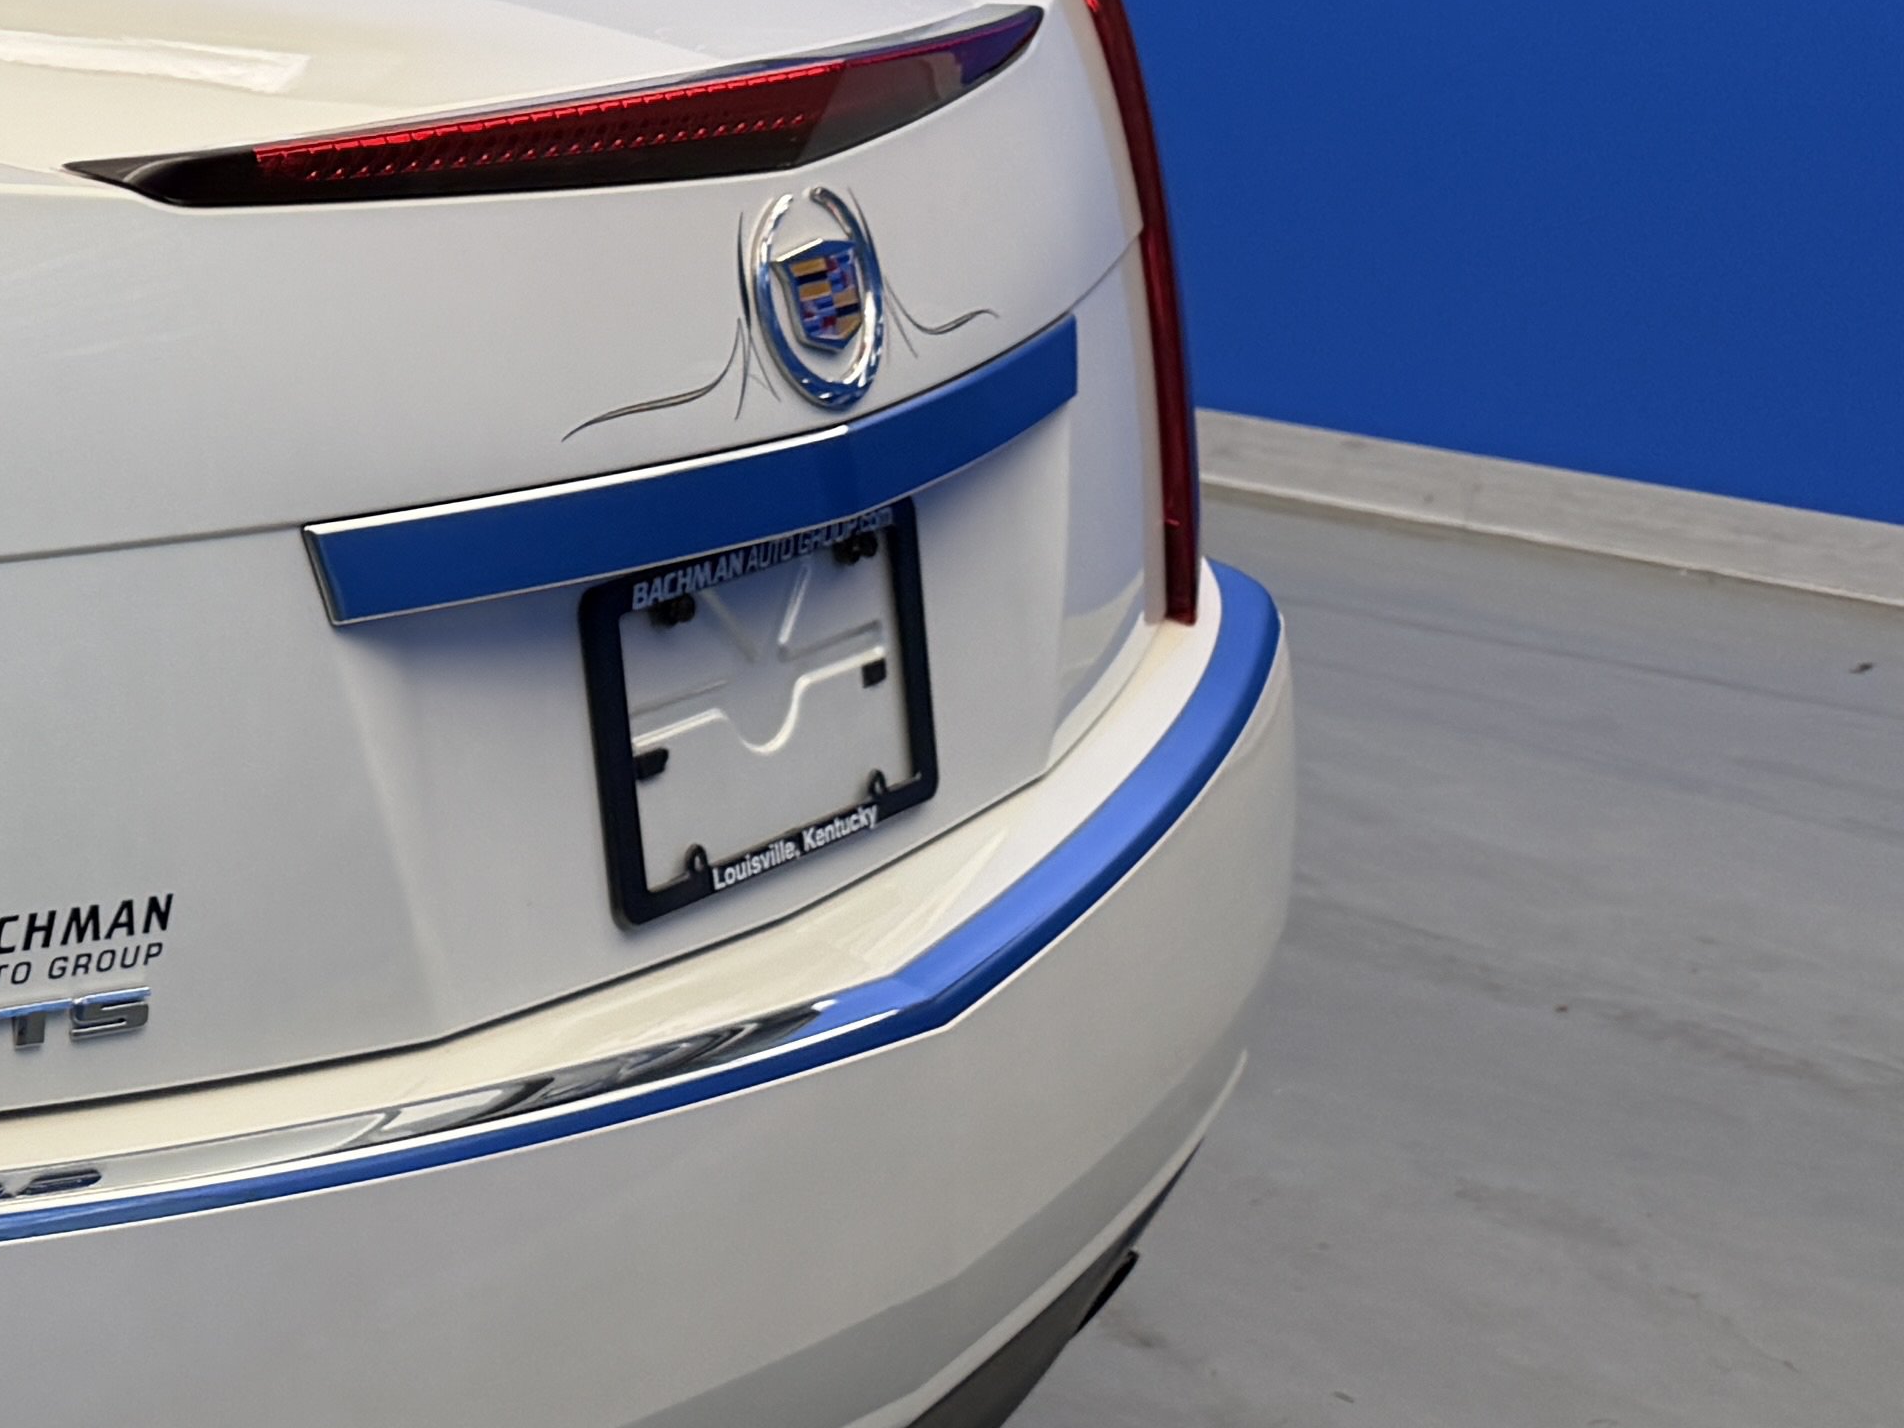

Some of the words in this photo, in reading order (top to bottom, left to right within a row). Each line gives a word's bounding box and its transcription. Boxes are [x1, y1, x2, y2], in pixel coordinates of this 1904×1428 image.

[632, 551, 743, 610] BACHMAN
[745, 539, 794, 569] AUTO
[712, 839, 801, 890] Louisville,
[802, 804, 878, 852] Kentucky
[47, 942, 163, 979] GROUP
